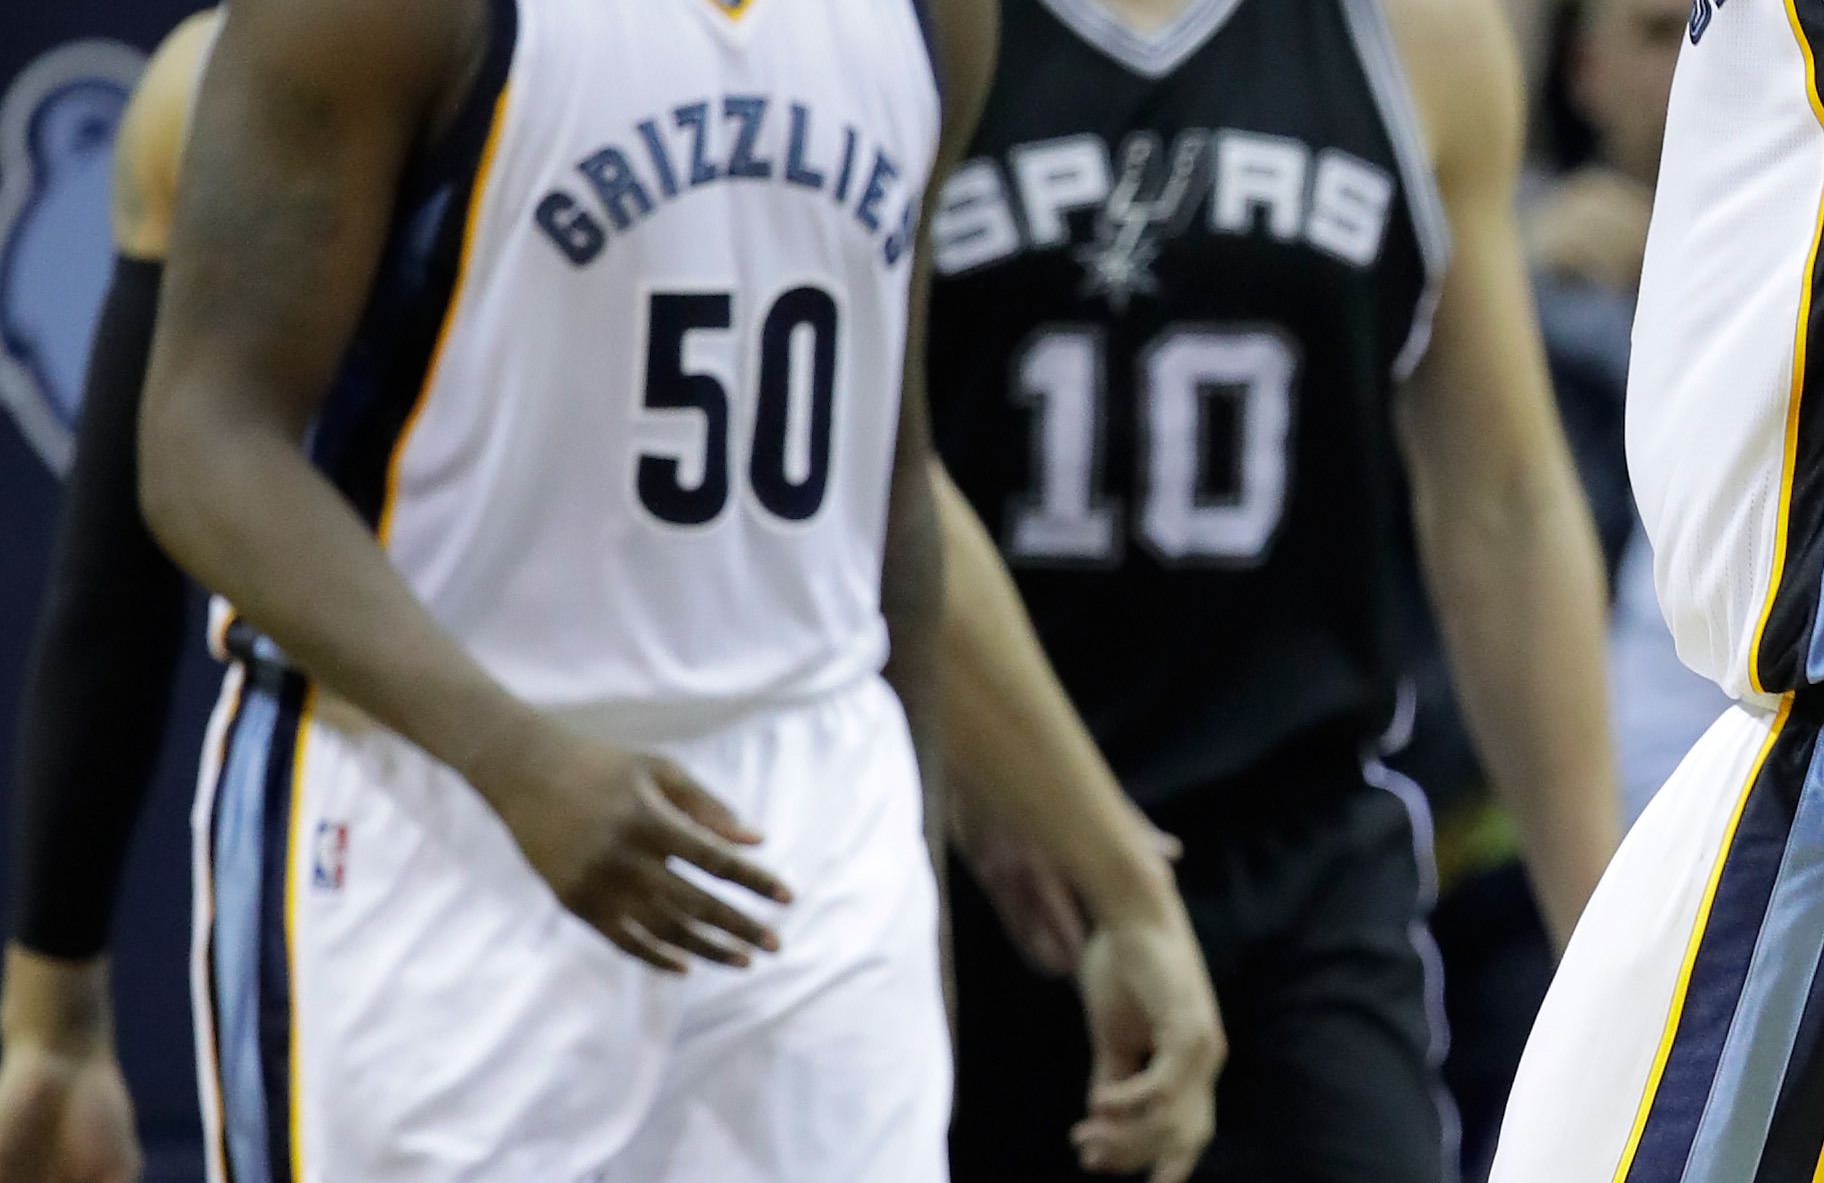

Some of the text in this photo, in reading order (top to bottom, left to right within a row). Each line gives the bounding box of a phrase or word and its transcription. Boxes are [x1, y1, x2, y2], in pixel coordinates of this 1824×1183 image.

[930, 129, 1397, 287] SPURS
[636, 285, 840, 525] 50
[1010, 327, 1298, 562] 10
